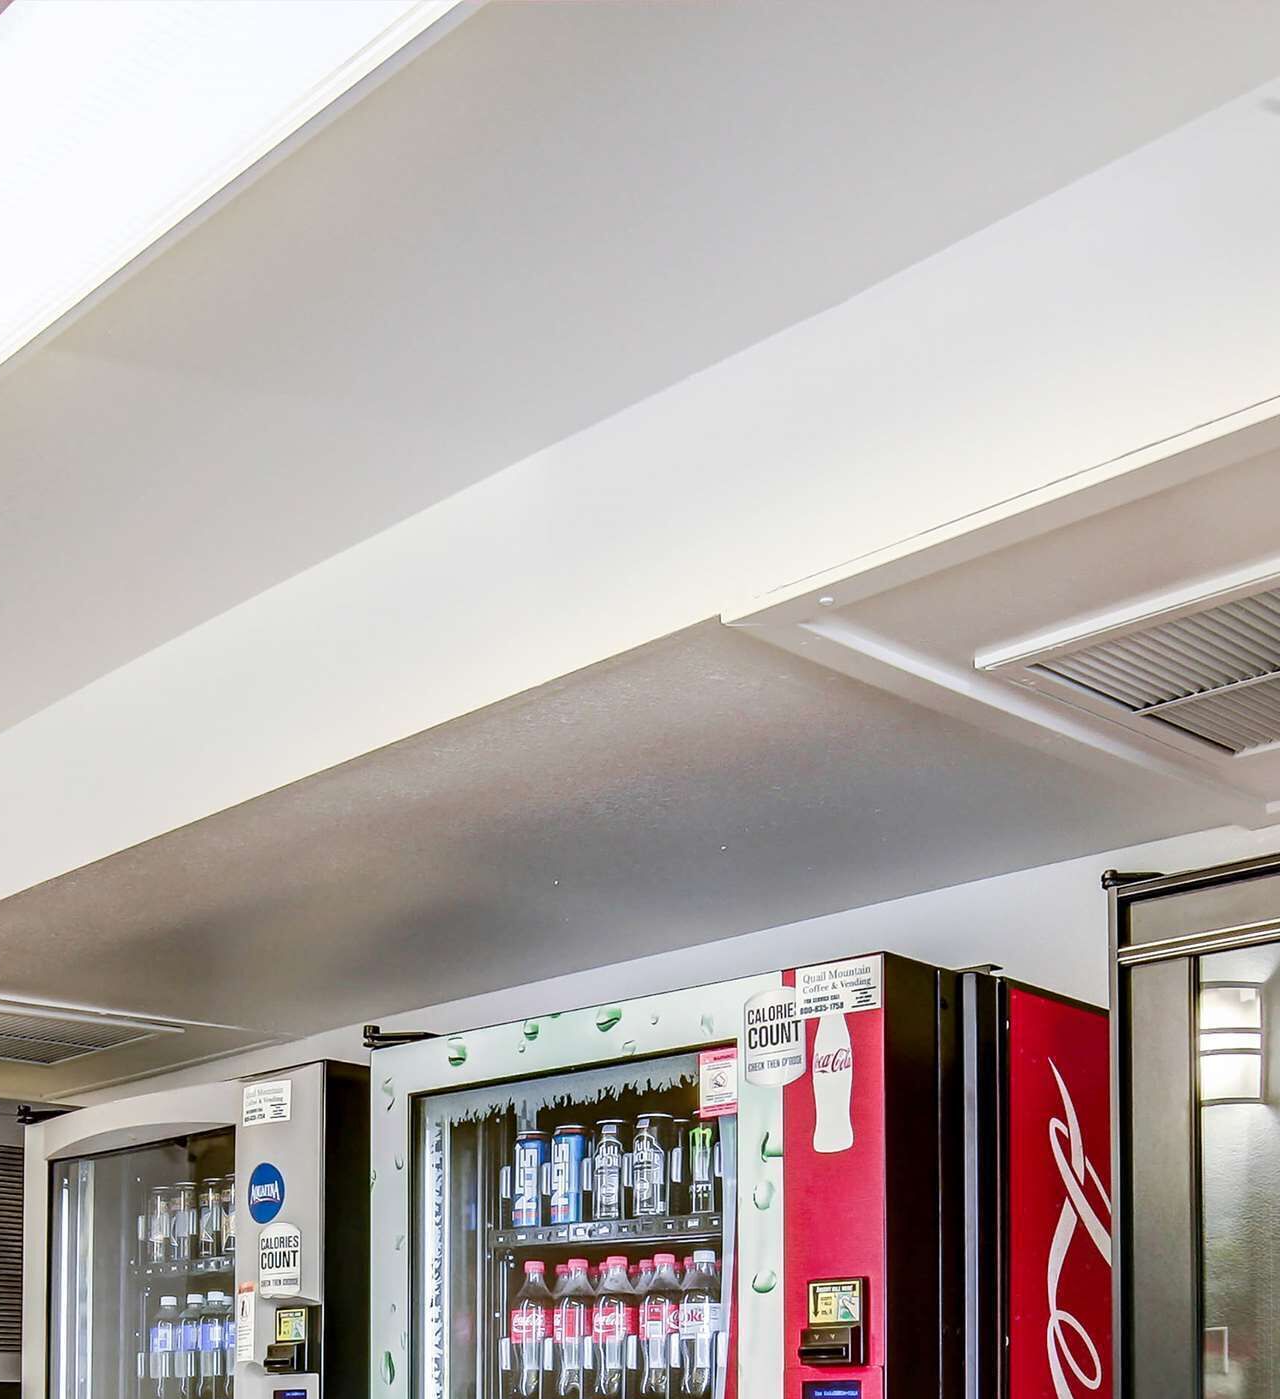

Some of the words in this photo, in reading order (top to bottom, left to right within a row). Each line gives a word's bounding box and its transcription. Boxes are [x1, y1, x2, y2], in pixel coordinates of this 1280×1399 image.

[802, 971, 826, 985] Quail
[828, 964, 871, 979] Mountain
[802, 983, 830, 994] Coffee
[840, 977, 871, 988] Vending
[747, 1003, 797, 1025] CALORIE
[748, 1019, 802, 1050] COUNT
[260, 1235, 299, 1251] CALORIES
[260, 1250, 299, 1270] COUNT
